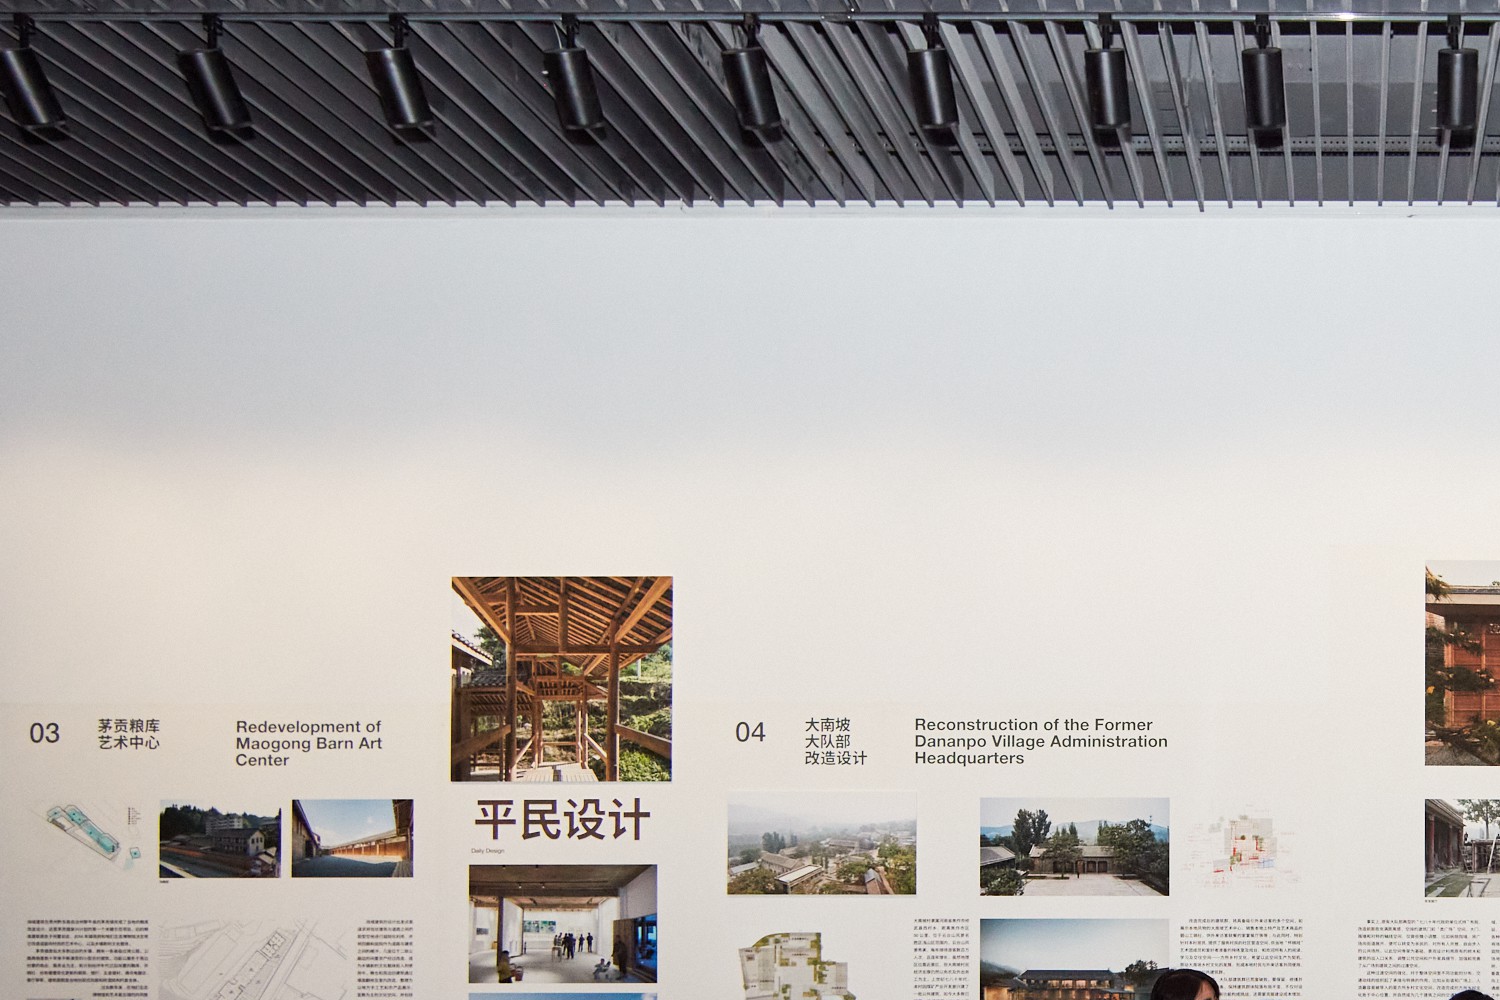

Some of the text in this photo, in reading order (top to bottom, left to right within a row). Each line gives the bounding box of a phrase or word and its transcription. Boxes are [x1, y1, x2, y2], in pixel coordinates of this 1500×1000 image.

[99, 719, 159, 733] 茅贡粮库
[237, 721, 381, 735] Redevelopment of
[806, 717, 850, 732] 大南坡
[916, 719, 1153, 730] Reconstruction of the Former
[30, 723, 59, 743] 03
[736, 722, 766, 742] 04
[98, 735, 159, 749] 艺术中心
[237, 737, 382, 752] Maogong Barn Art
[806, 734, 850, 748] 大队部
[916, 735, 1167, 750] Dananpo Village Administration
[236, 754, 289, 766] Center
[805, 751, 867, 765] 改造设计
[916, 752, 1024, 766] Headquarters
[475, 798, 650, 840] 平民设计
